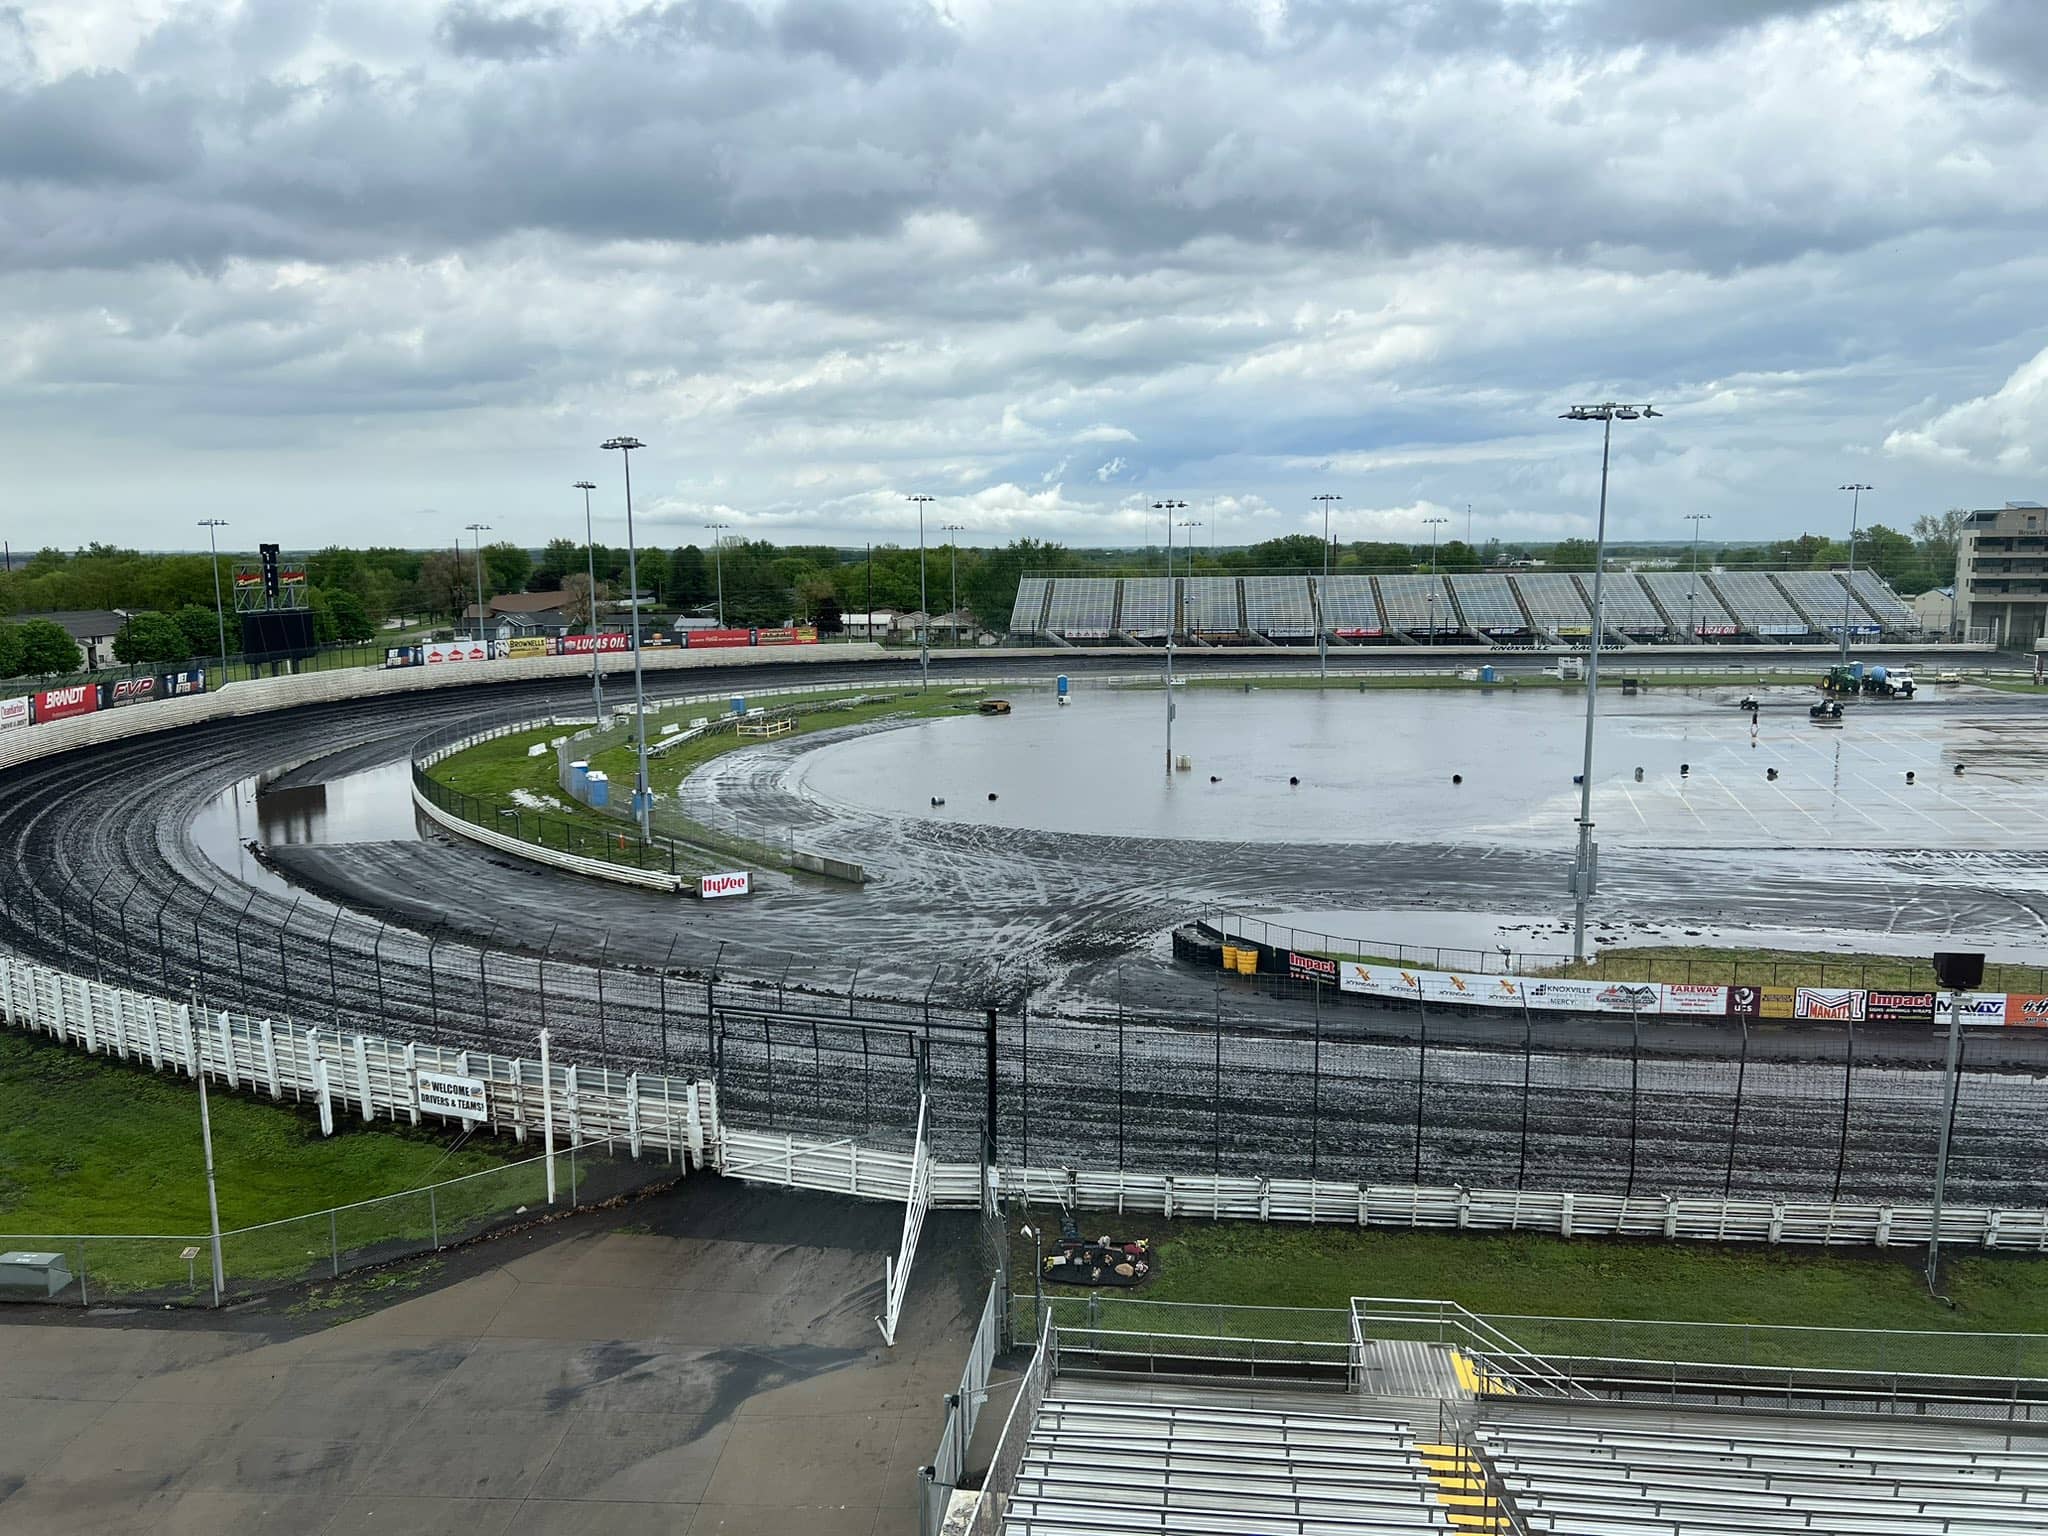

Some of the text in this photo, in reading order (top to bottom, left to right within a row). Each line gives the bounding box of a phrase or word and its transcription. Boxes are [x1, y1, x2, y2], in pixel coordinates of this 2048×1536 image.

[609, 636, 625, 649] OIL
[113, 677, 154, 699] FVP
[44, 686, 87, 710] BRANDT
[1289, 951, 1336, 975] Impact
[1547, 985, 1592, 994] KNOXVILLE
[1670, 984, 1720, 994] FAREWAY
[1869, 992, 1933, 1008] Impact
[431, 1081, 471, 1097] WELCOME
[420, 1093, 485, 1113] DRIVERS & TEAMS!
